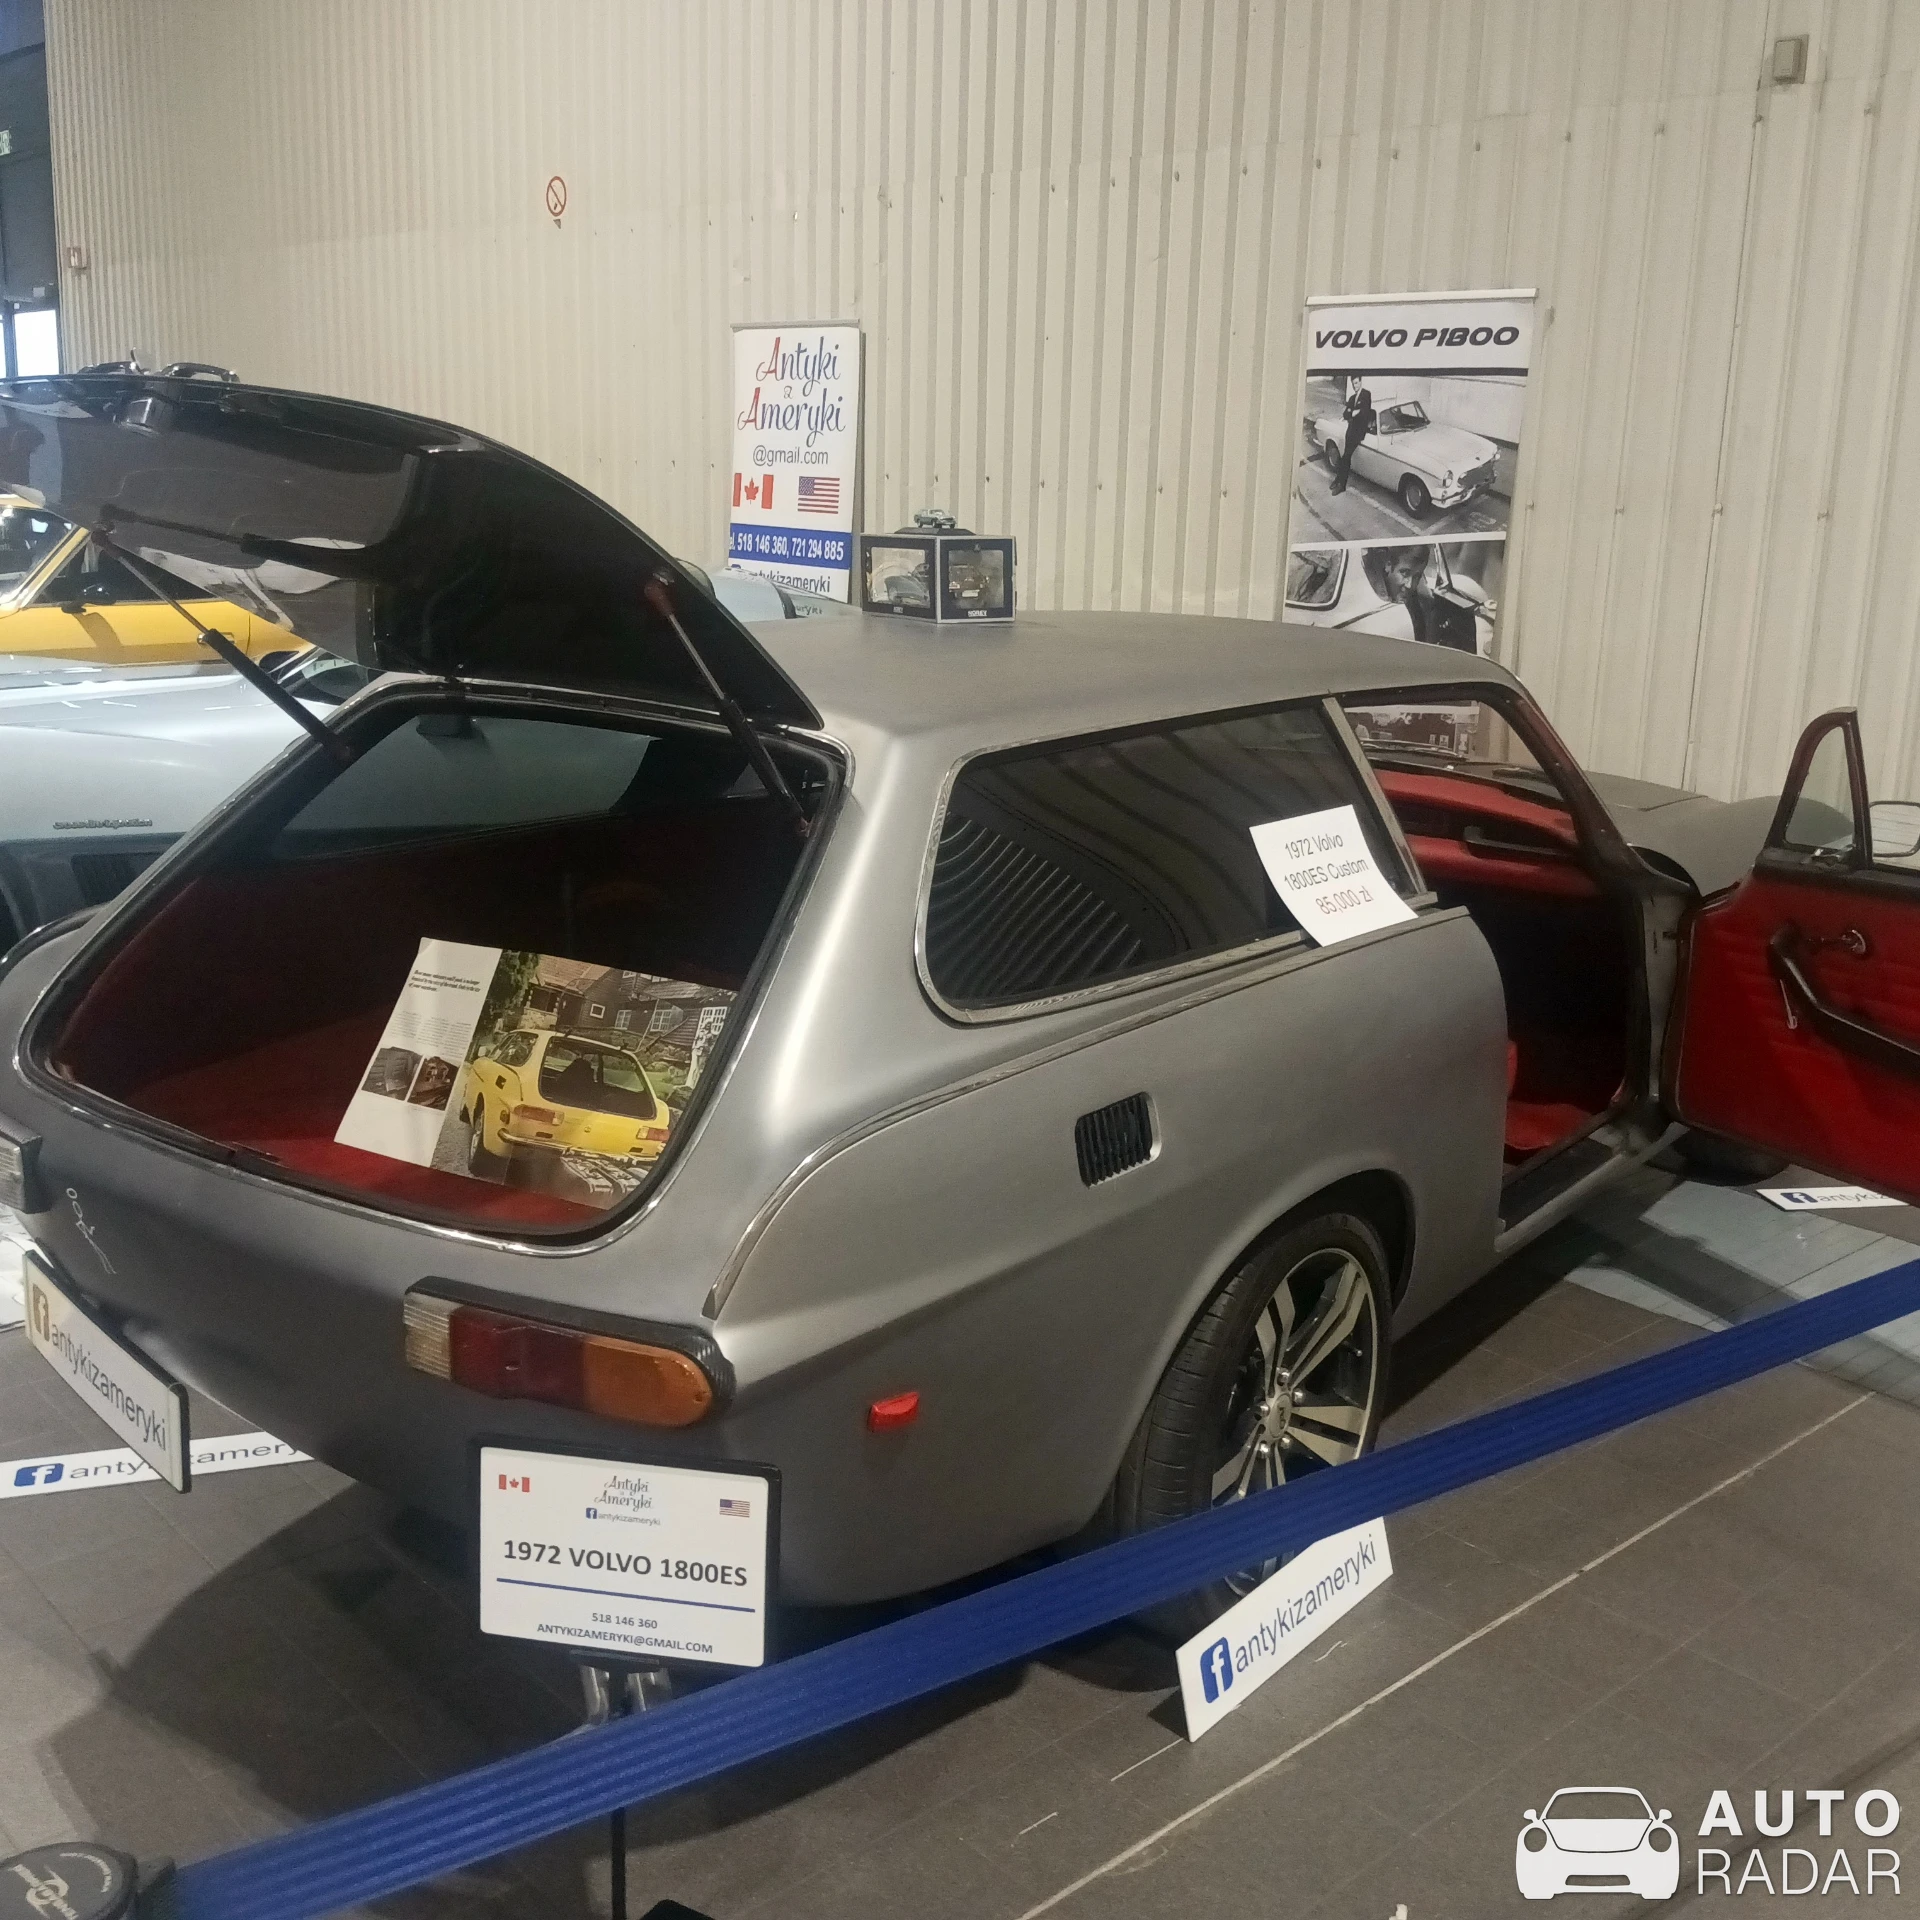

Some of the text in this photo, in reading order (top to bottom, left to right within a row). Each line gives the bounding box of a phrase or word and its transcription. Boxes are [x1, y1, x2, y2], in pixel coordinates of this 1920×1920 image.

[1315, 325, 1520, 349] VOLVO P1800
[756, 336, 841, 397] Antyki
[737, 387, 846, 448] Ameryki
[753, 445, 829, 467] @gmail.com
[738, 533, 753, 552] 518
[755, 534, 770, 554] 146
[772, 536, 789, 558] 360,
[791, 537, 806, 557] 721
[807, 539, 823, 558] 294
[824, 540, 844, 560] 885
[1285, 833, 1344, 859] 1972 Volvo
[1284, 858, 1369, 891] 1800ES Custom
[1315, 889, 1361, 915] 85,000
[51, 1323, 166, 1452] antykizameryki
[603, 1475, 649, 1496] Antyki
[594, 1490, 653, 1512] Ameryki
[598, 1512, 661, 1526] antykizameryki
[504, 1540, 748, 1587] 1972 VOLVO 1800ES
[1235, 1533, 1377, 1673] antykizameryki
[591, 1612, 658, 1630] 518 146 360
[537, 1623, 713, 1654] ANTYKIZAMERYKI@GMAIL.COM
